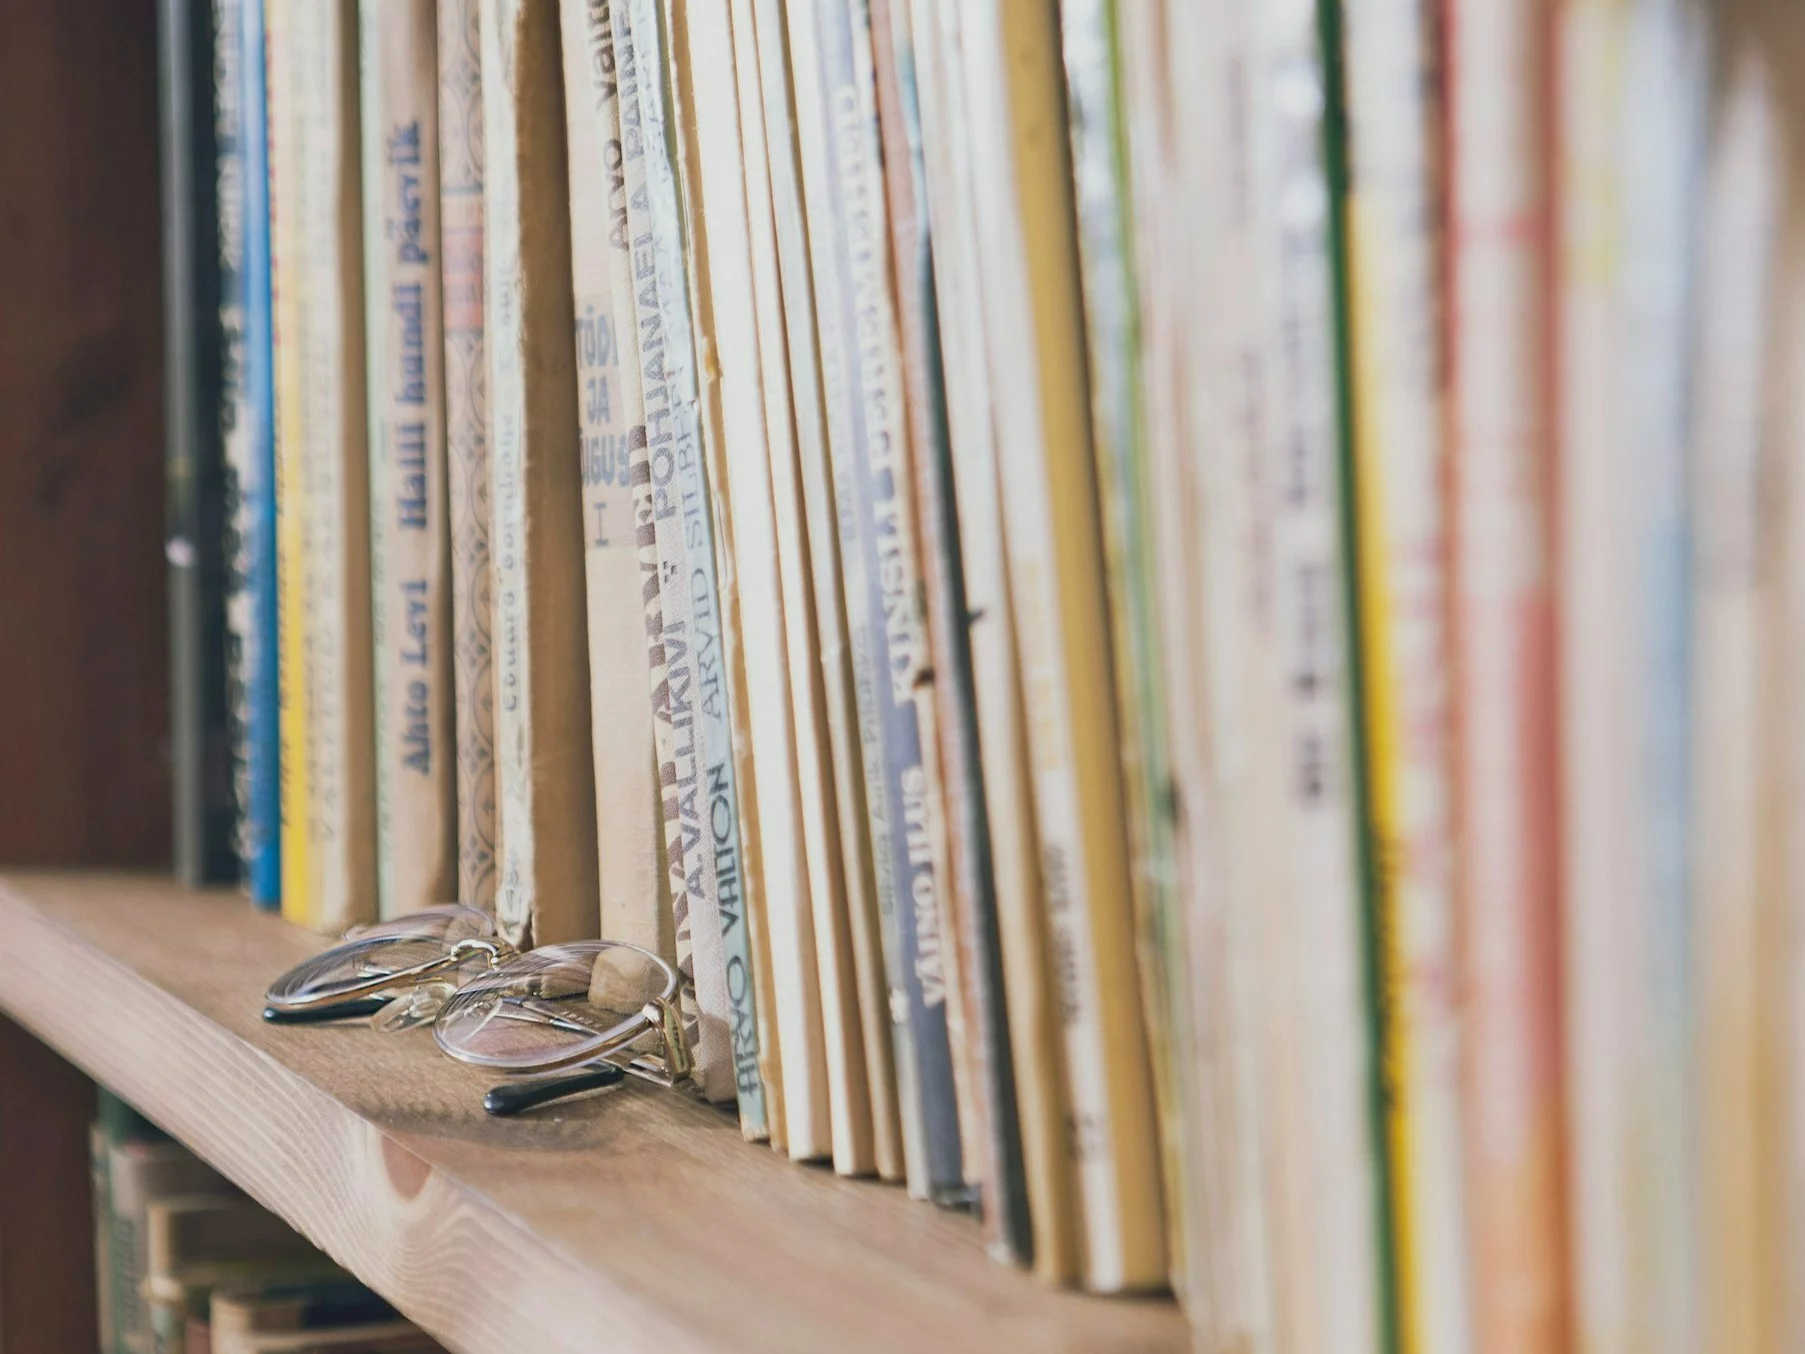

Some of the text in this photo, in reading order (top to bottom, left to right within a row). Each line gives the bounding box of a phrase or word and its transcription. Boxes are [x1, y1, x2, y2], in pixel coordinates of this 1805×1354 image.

[604, 138, 630, 251] Arvo
[392, 284, 425, 405] hundi
[587, 376, 612, 425] JA
[396, 422, 428, 530] Halli
[400, 579, 429, 666] Levi
[690, 567, 723, 726] ARVID
[401, 680, 430, 776] Ahto
[706, 761, 741, 937] VALTON
[726, 955, 760, 1098] ARVO
